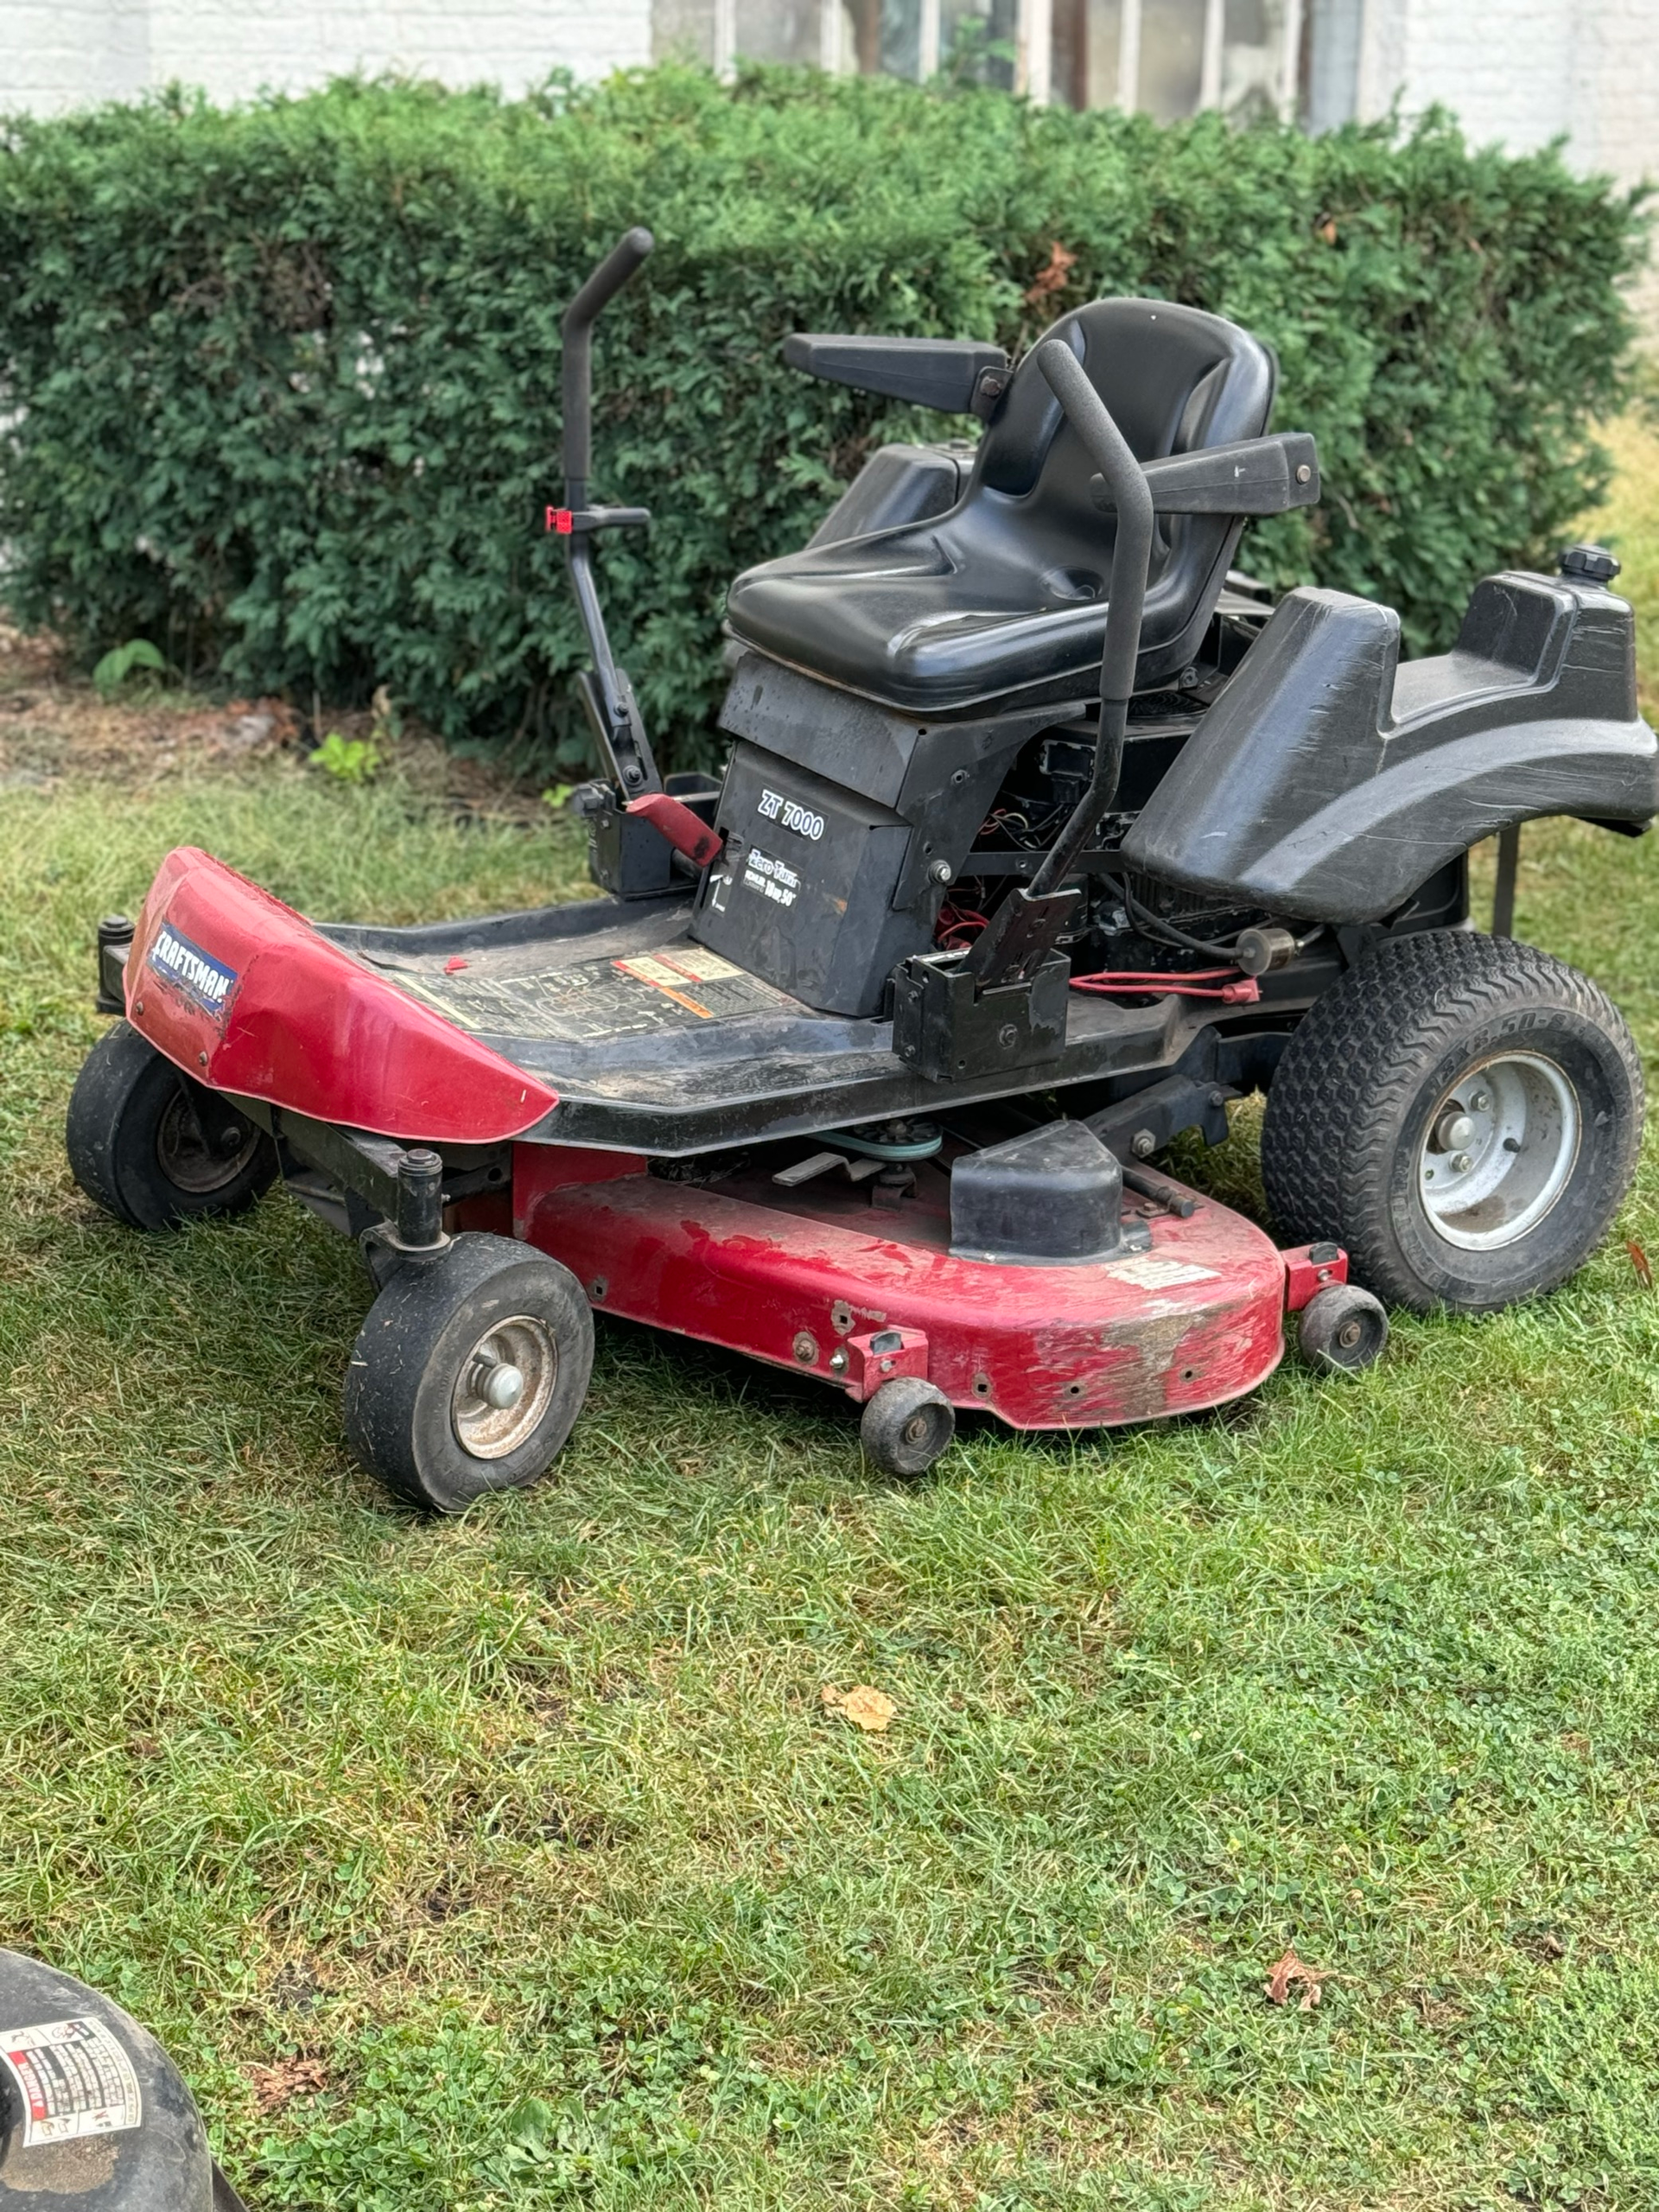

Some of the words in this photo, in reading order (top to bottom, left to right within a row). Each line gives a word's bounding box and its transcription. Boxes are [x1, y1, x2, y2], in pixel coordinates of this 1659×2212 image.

[757, 789, 785, 819] ZT
[782, 801, 824, 841] 7000
[747, 849, 774, 875] Zero
[152, 931, 230, 1003] CRAFTSMAN
